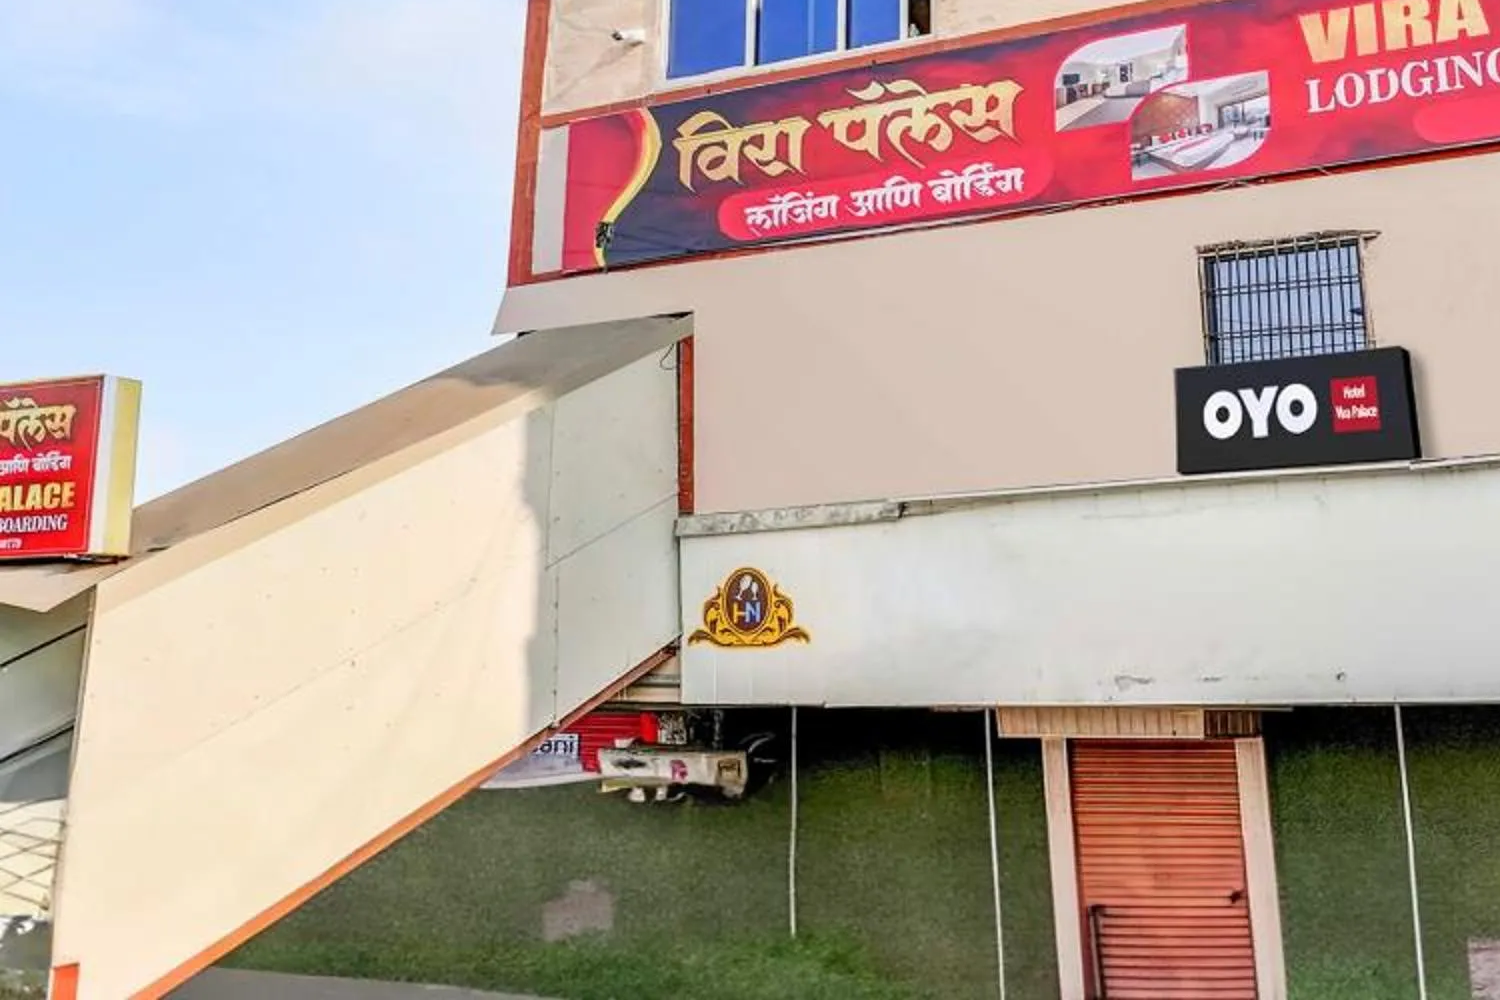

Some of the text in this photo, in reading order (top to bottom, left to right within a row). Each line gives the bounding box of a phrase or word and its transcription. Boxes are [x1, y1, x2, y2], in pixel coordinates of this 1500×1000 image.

[673, 79, 1024, 192] विरा पॅलेस
[744, 190, 841, 236] लॉजिंग
[848, 175, 922, 217] आणि
[1203, 383, 1318, 440] OYO
[0, 481, 76, 512] ALACE
[532, 734, 574, 754] ani
